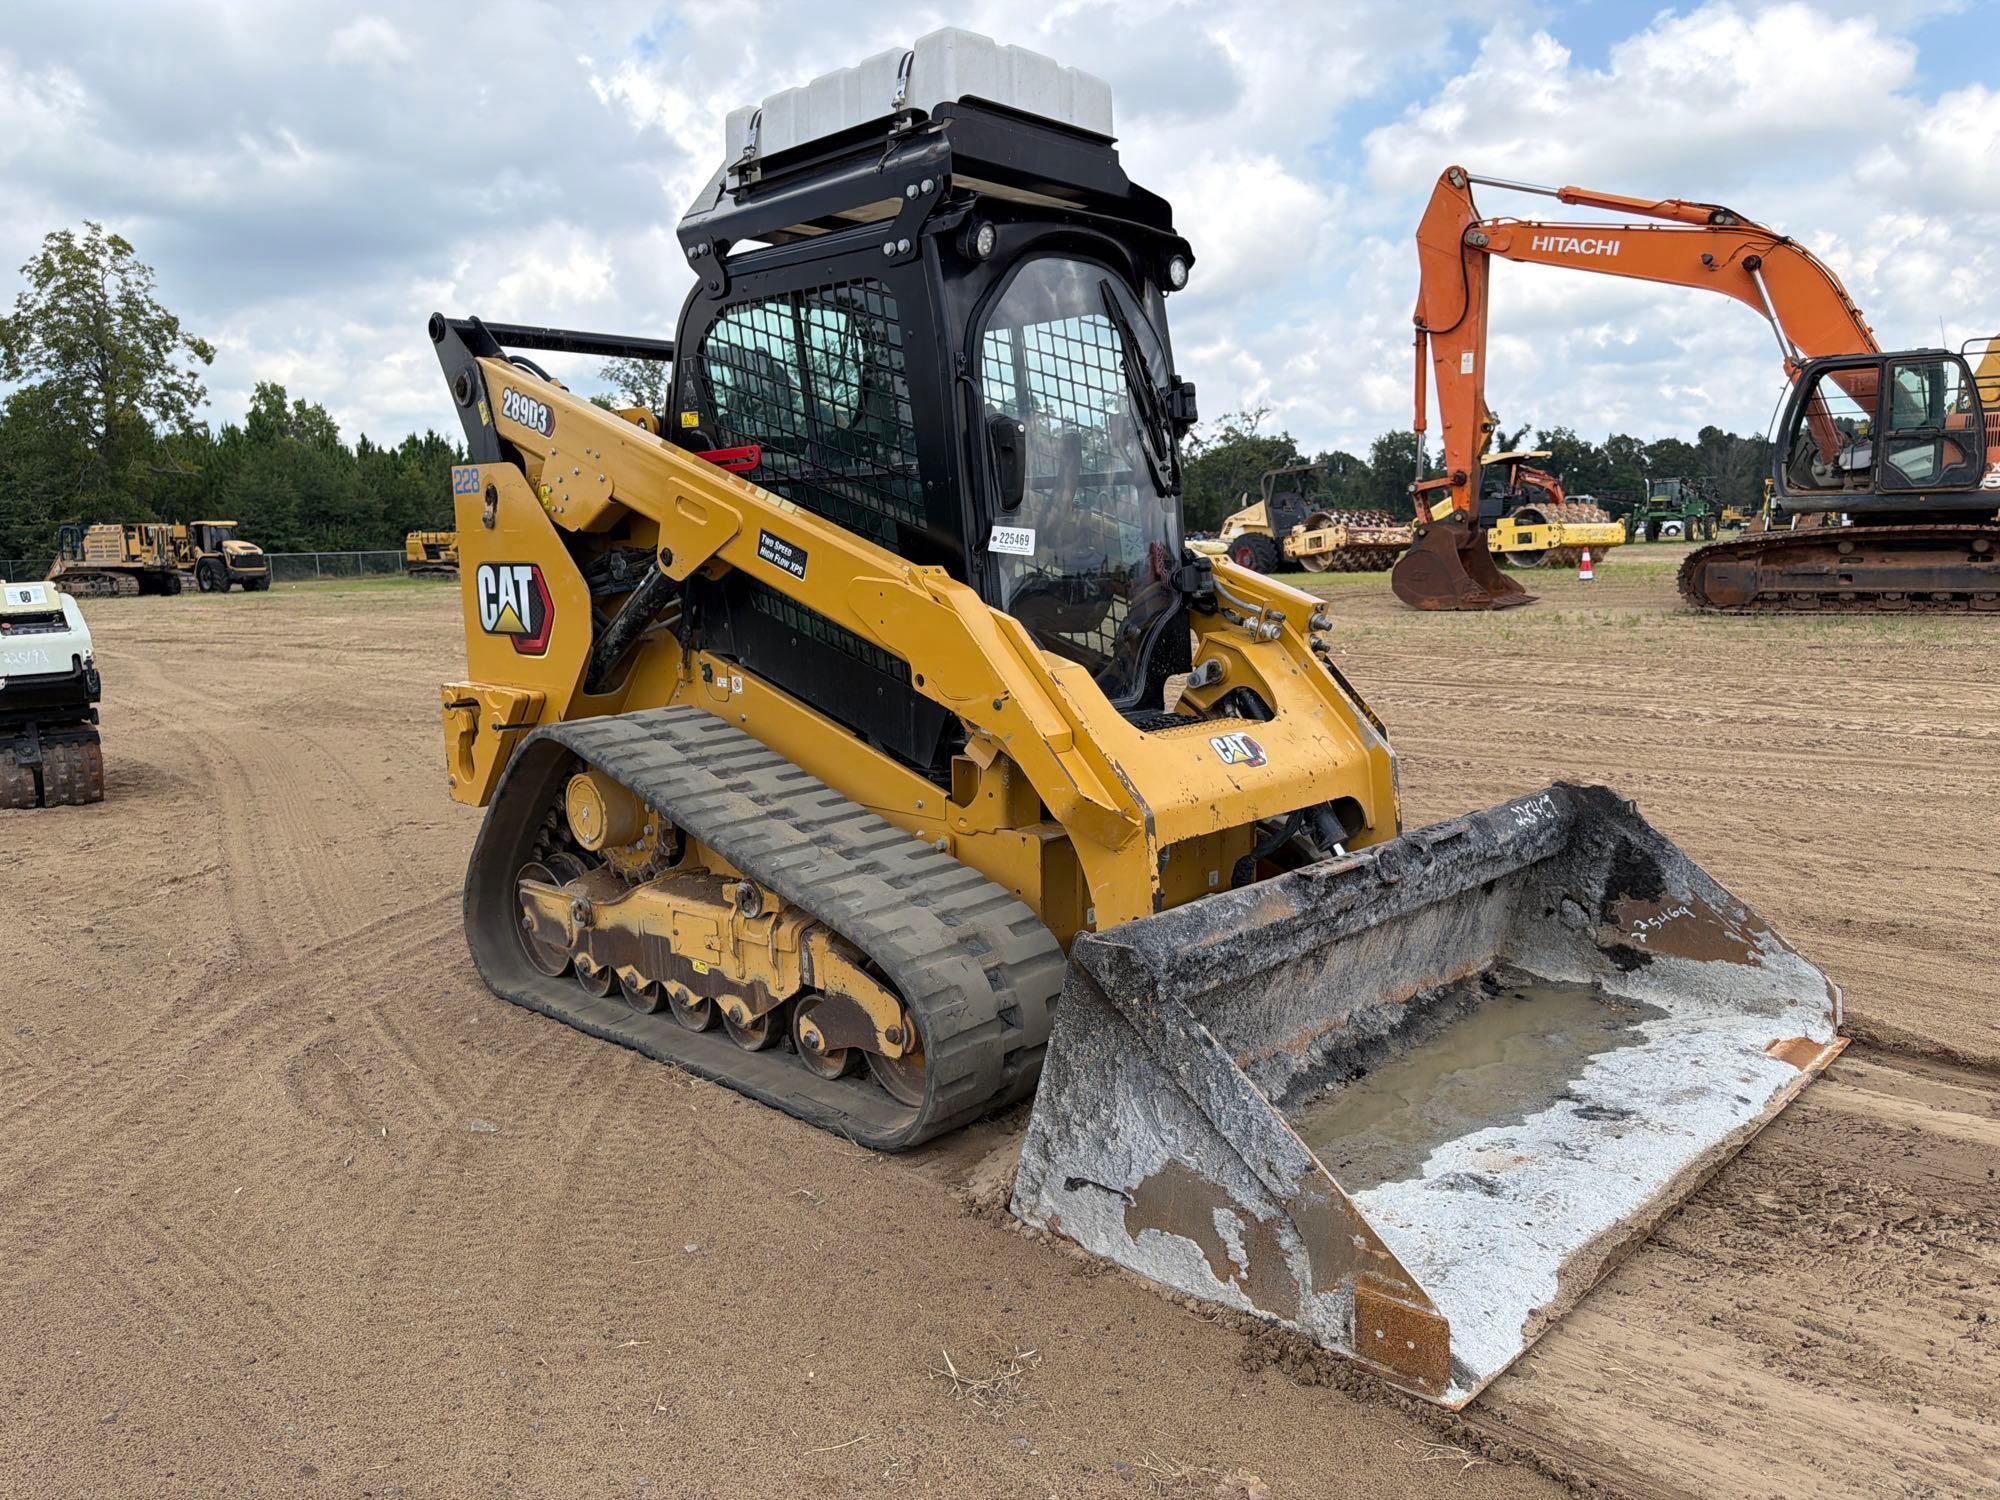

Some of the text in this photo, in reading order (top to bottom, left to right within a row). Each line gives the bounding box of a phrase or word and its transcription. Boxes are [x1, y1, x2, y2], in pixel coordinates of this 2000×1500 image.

[1531, 235, 1620, 257] HITACHI
[502, 388, 549, 435] 289D3
[453, 467, 480, 495] 228
[999, 531, 1030, 547] 225469
[789, 561, 804, 576] XPS
[477, 564, 533, 634] CAT
[1210, 733, 1256, 764] CAT
[1631, 905, 1696, 943] 225469
